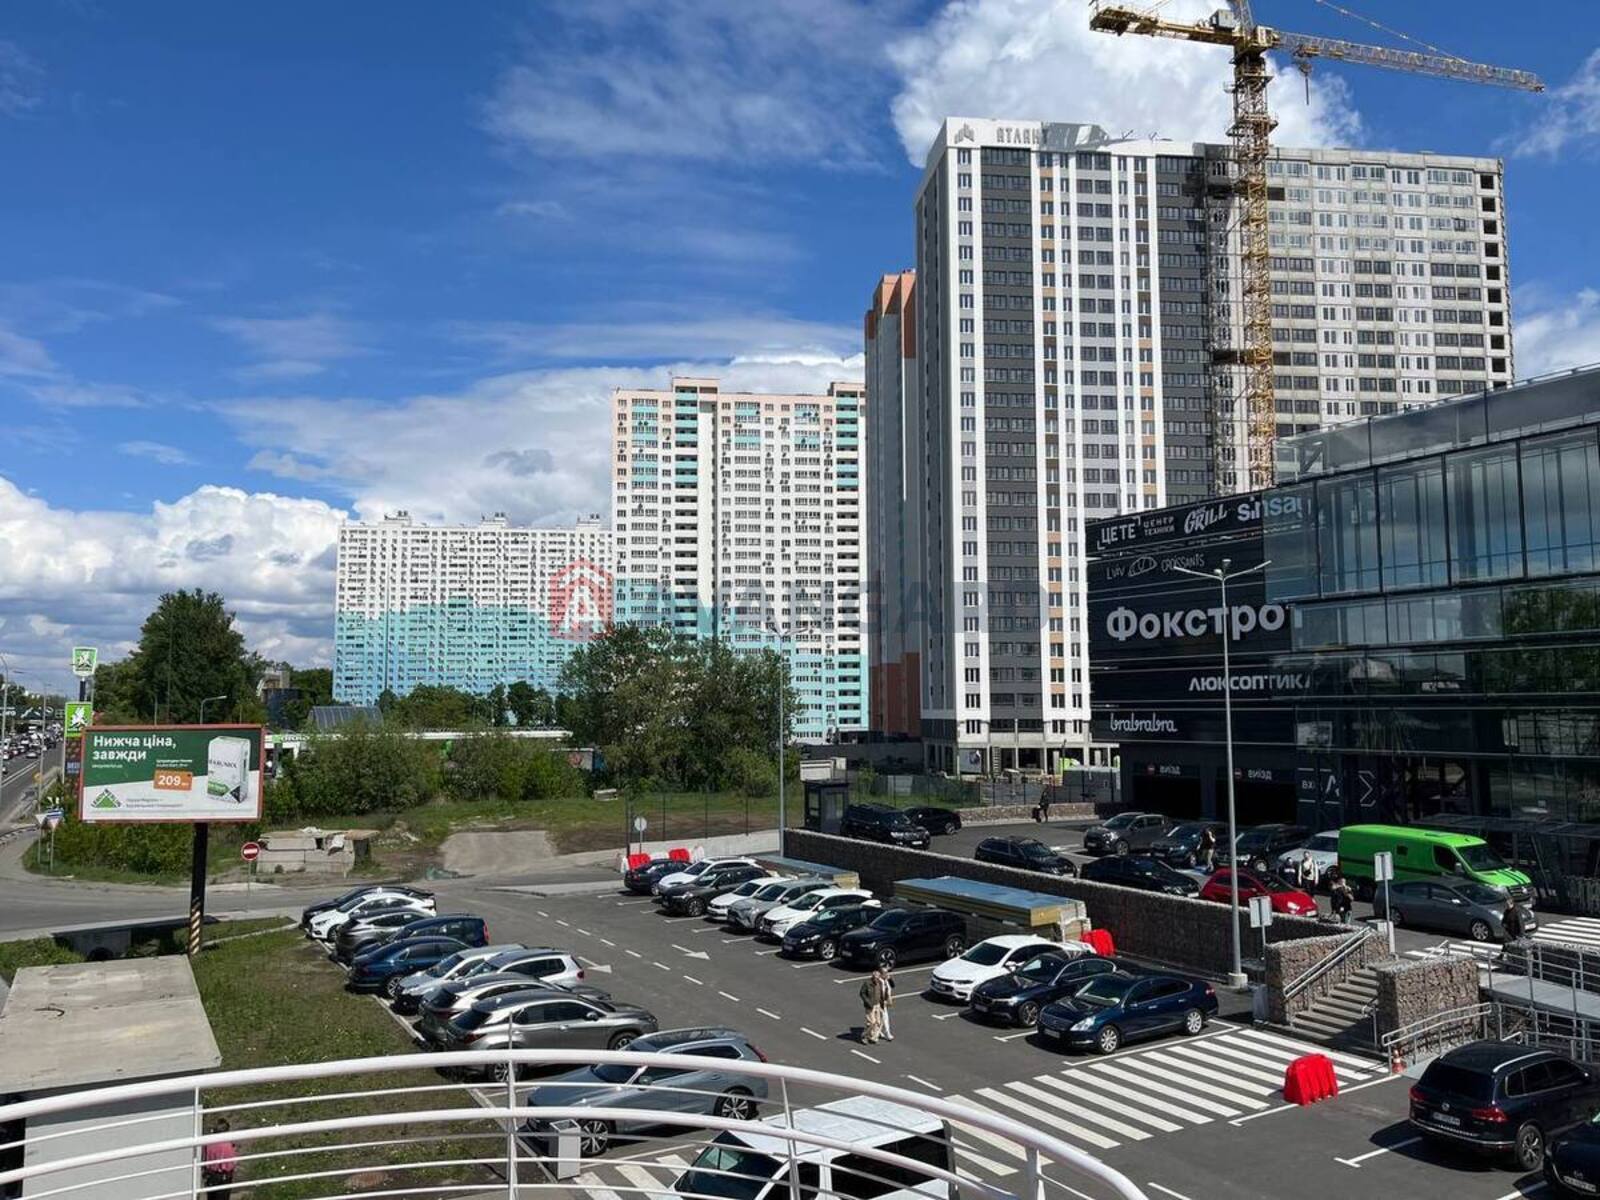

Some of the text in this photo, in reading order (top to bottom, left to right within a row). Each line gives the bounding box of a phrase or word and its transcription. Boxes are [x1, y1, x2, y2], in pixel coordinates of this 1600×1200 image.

[1184, 504, 1228, 534] GRILL
[1101, 523, 1136, 545] ЦЕТЕ
[1110, 712, 1178, 732] brabrabra
[93, 734, 177, 749] Нижча ціна,
[92, 750, 147, 762] завжди
[158, 775, 181, 786] 209
